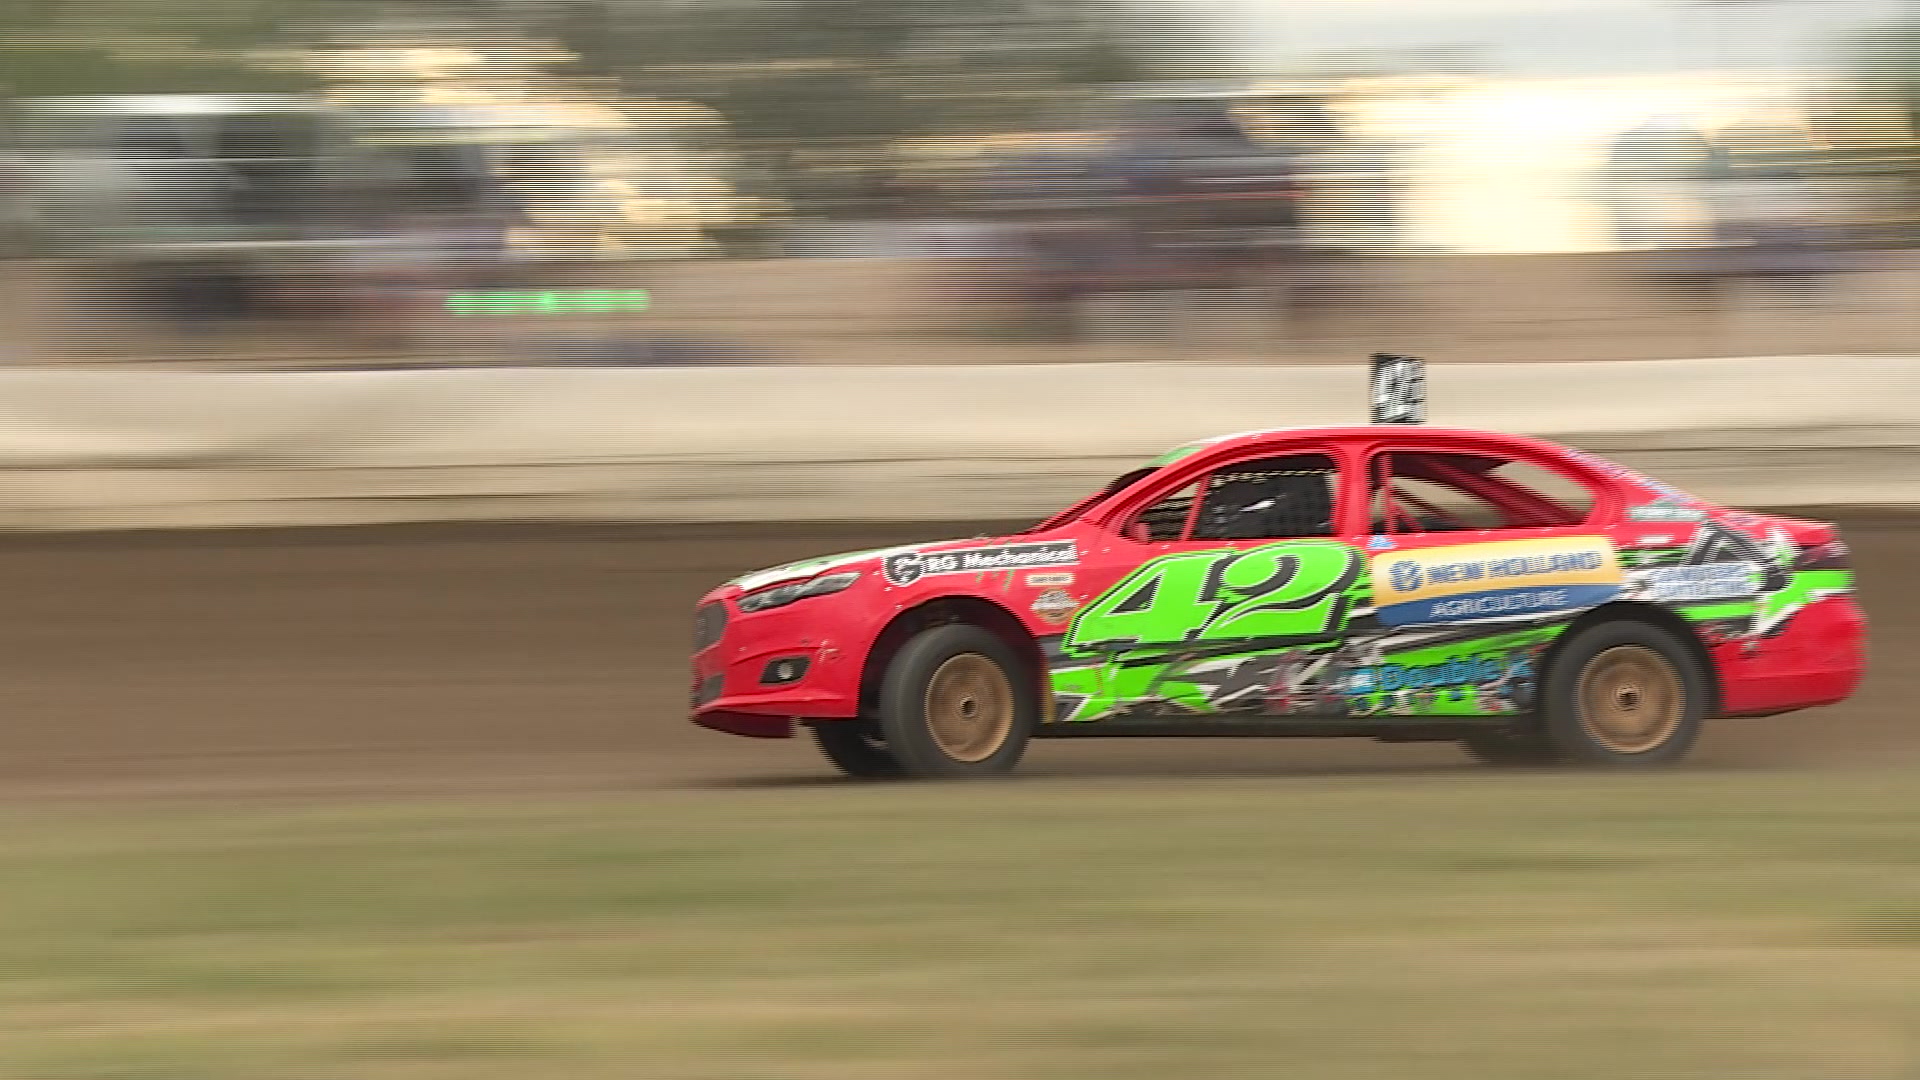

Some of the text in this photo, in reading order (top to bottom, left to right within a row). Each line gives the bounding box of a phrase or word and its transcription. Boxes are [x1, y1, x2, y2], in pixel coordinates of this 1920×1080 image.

[1374, 359, 1408, 420] 42
[926, 546, 1079, 573] RG Mechanical
[1427, 551, 1603, 585] NEW HOLLAND
[1066, 541, 1362, 648] 42
[1429, 589, 1568, 618] AGRICULTURE
[1380, 654, 1502, 692] Double
